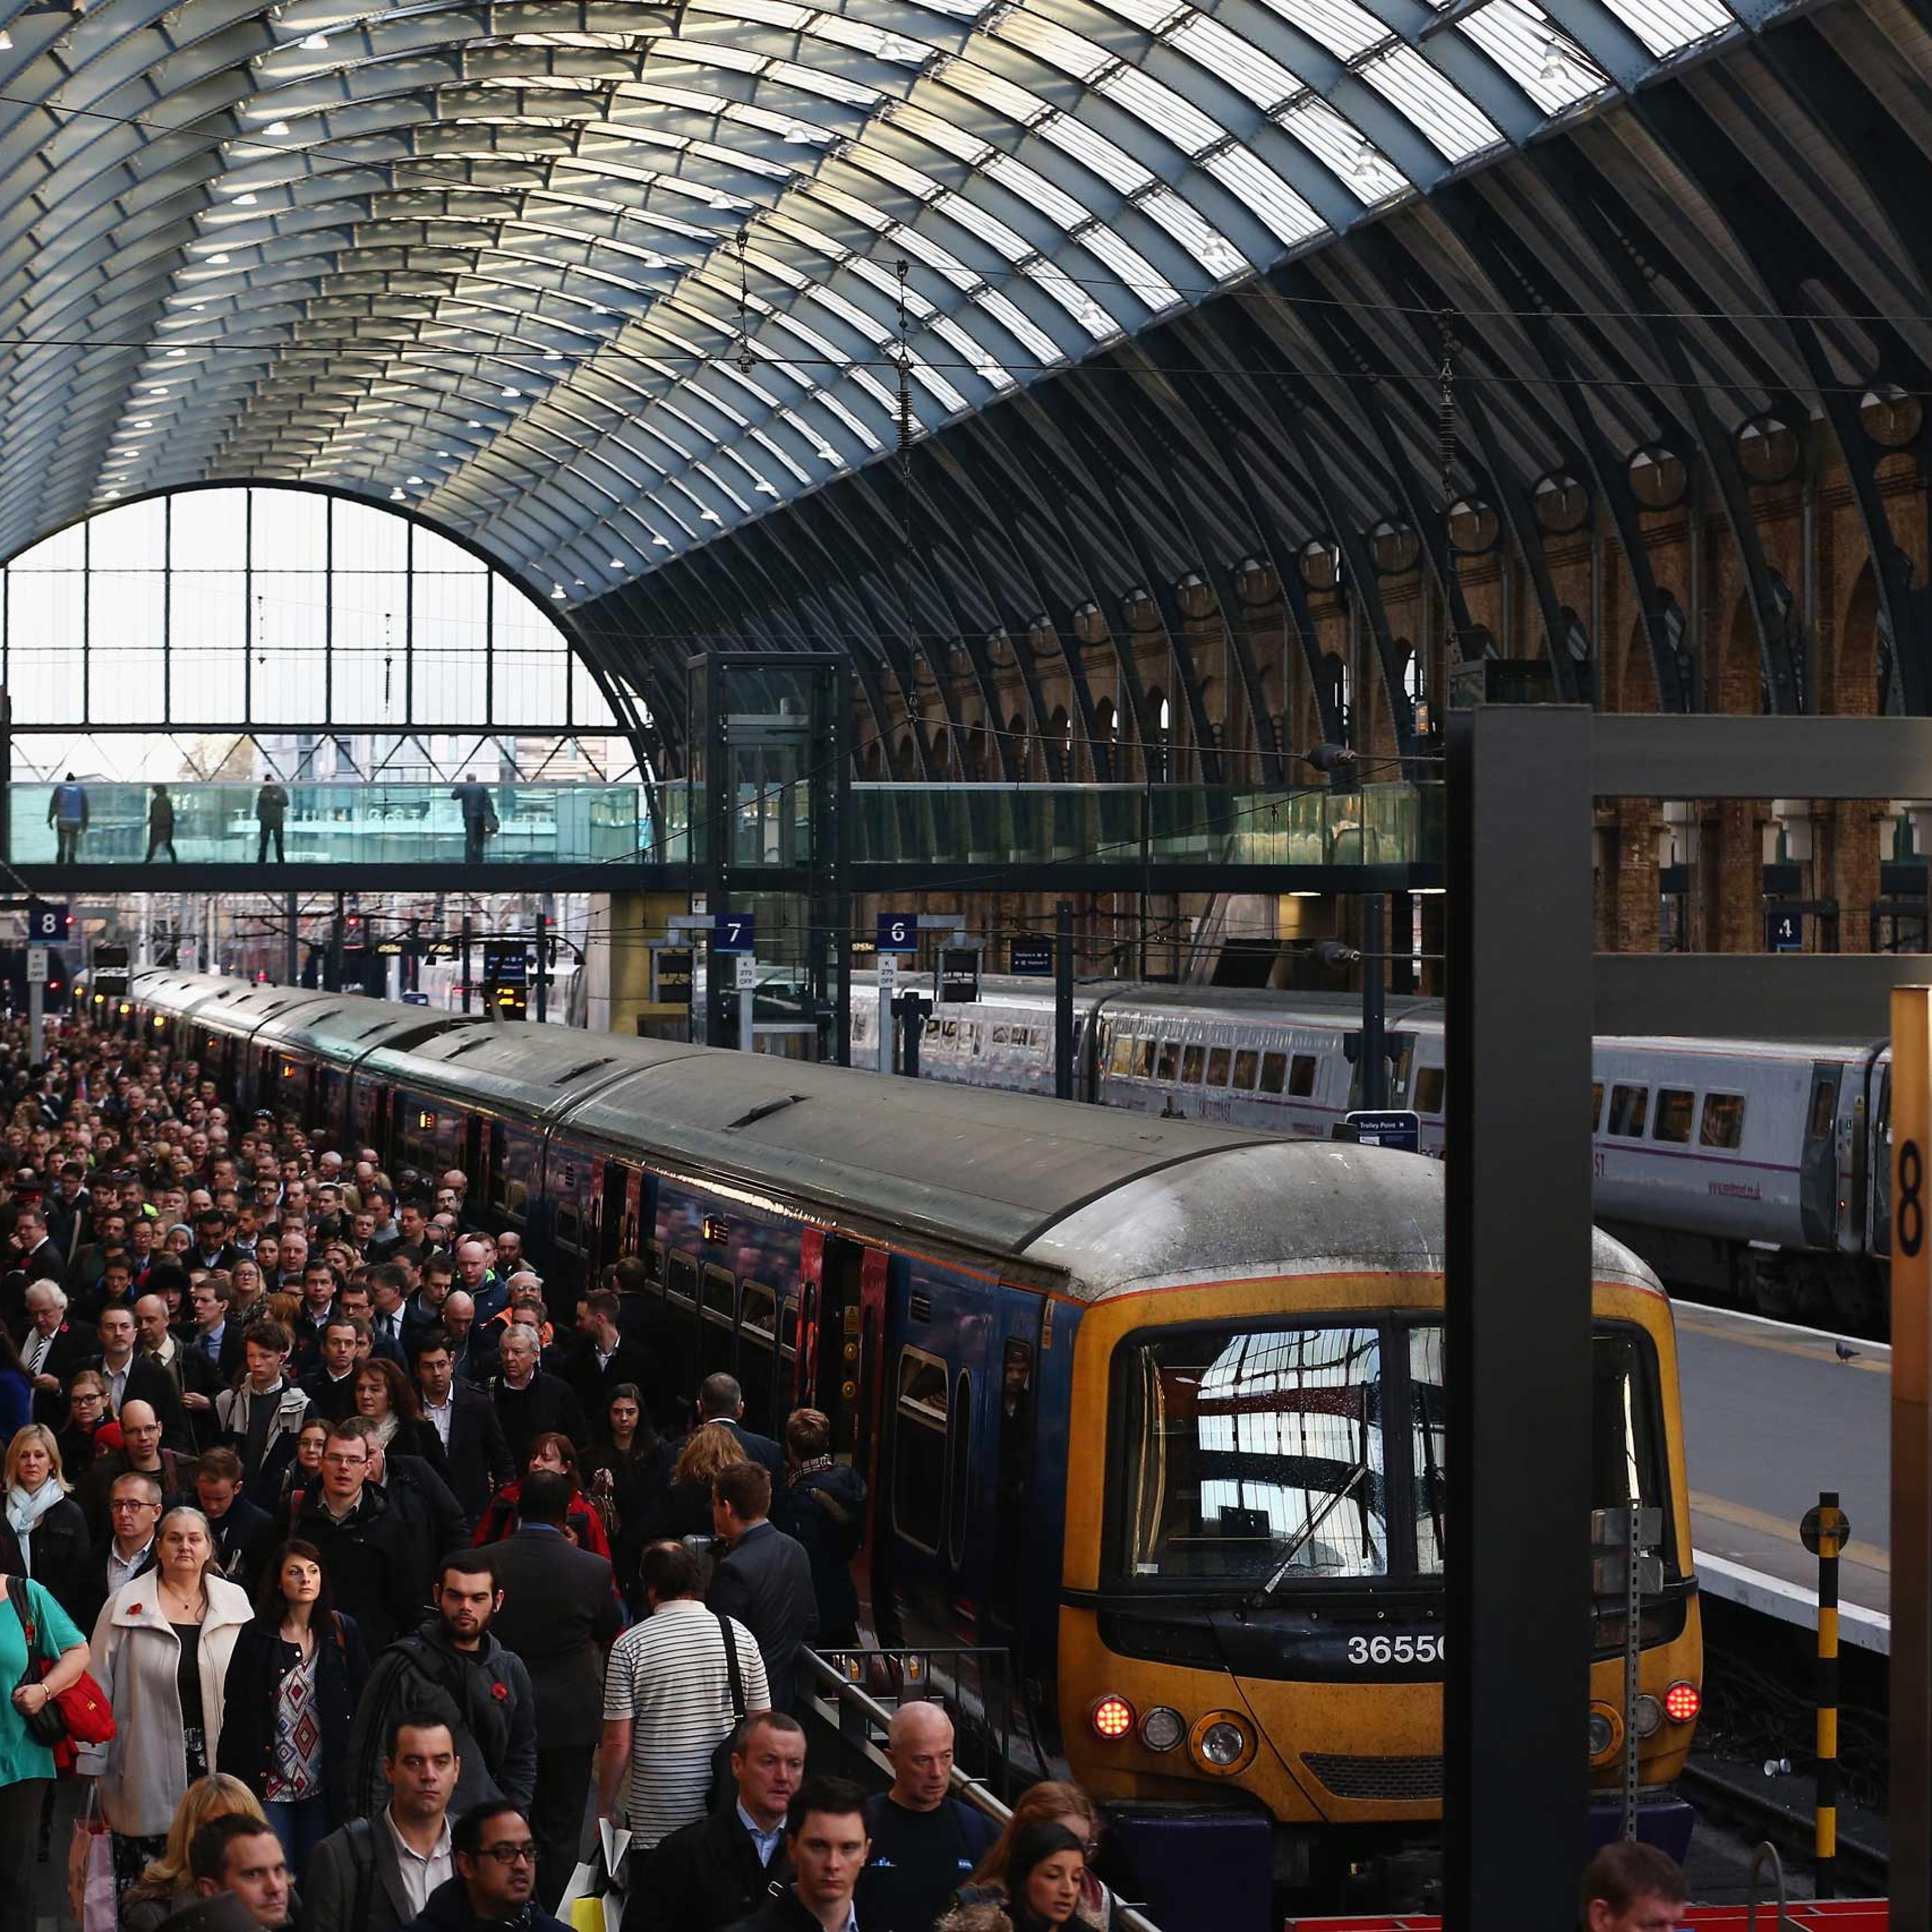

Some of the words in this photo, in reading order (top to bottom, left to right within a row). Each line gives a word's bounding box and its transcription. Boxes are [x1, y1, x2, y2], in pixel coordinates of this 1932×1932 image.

[42, 913, 56, 933] 8
[728, 923, 741, 942] 7
[892, 922, 905, 942] 6
[1779, 919, 1792, 938] 4
[1898, 1139, 1923, 1258] 8
